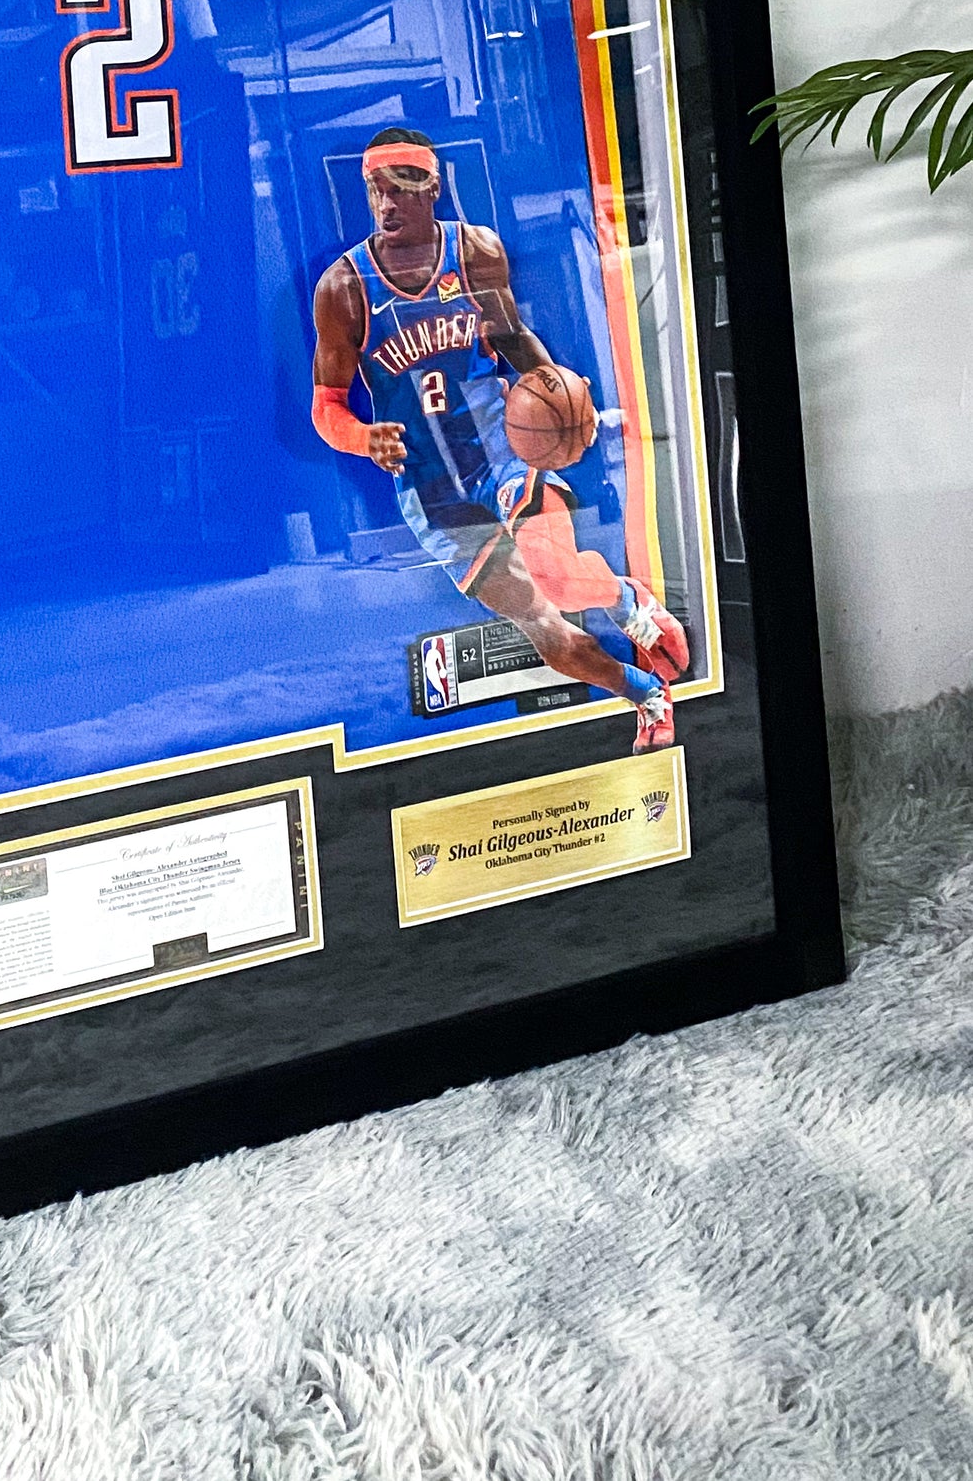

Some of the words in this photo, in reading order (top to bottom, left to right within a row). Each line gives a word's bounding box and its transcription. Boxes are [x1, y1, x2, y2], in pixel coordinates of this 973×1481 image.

[370, 313, 476, 377] THUNDER
[421, 370, 448, 415] 2
[461, 647, 477, 663] 52
[429, 692, 444, 708] NBA
[492, 810, 544, 829] Personally
[545, 802, 578, 819] Signed
[578, 799, 591, 813] by
[641, 790, 669, 807] THUNDER
[448, 839, 483, 861] Shai
[487, 807, 636, 853] Gilgeous-Alexander
[294, 821, 309, 908] PANINI
[408, 843, 441, 861] THUNDER
[485, 852, 533, 869] Oklahoma
[534, 845, 553, 858] City
[553, 838, 593, 854] Thunder
[593, 833, 606, 844] #2
